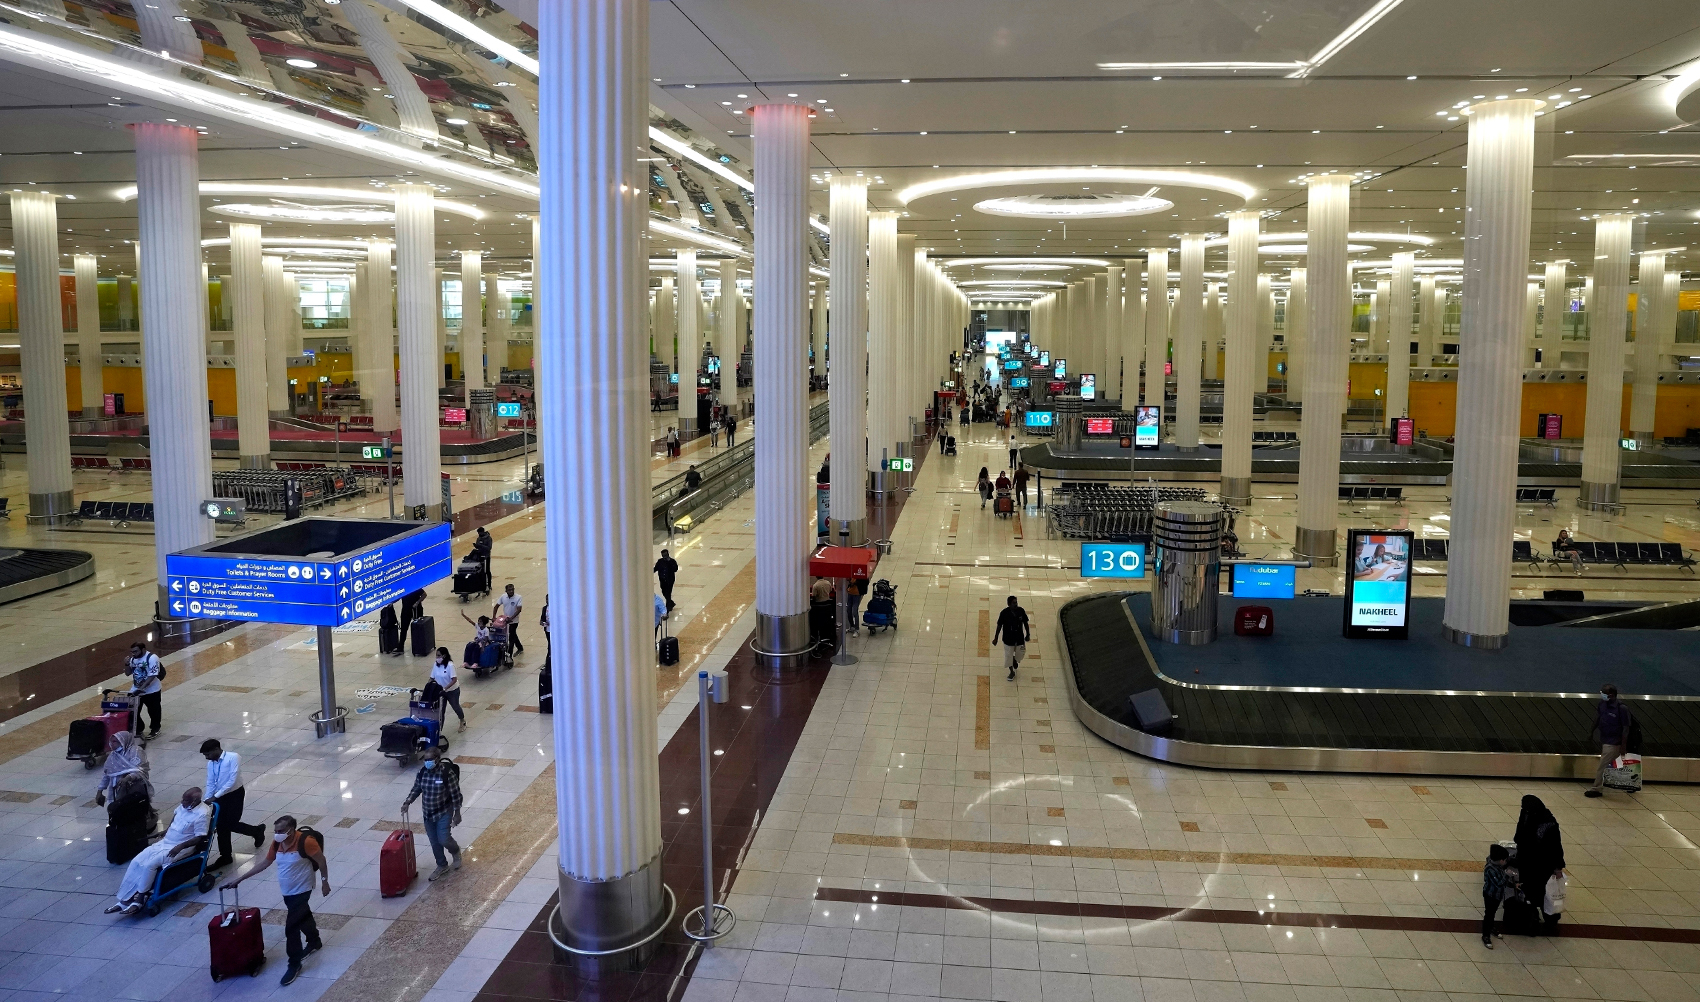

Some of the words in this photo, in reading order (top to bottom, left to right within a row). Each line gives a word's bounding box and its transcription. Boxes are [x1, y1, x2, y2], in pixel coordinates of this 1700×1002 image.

[509, 406, 519, 415] 12
[1030, 415, 1040, 423] 11
[364, 561, 373, 569] Duty
[1088, 550, 1114, 571] 13
[365, 582, 374, 590] Duty
[384, 571, 401, 582] Customer
[402, 565, 416, 574] Services
[366, 599, 382, 609] Baggage
[383, 588, 405, 600] Information
[227, 609, 258, 617] Information
